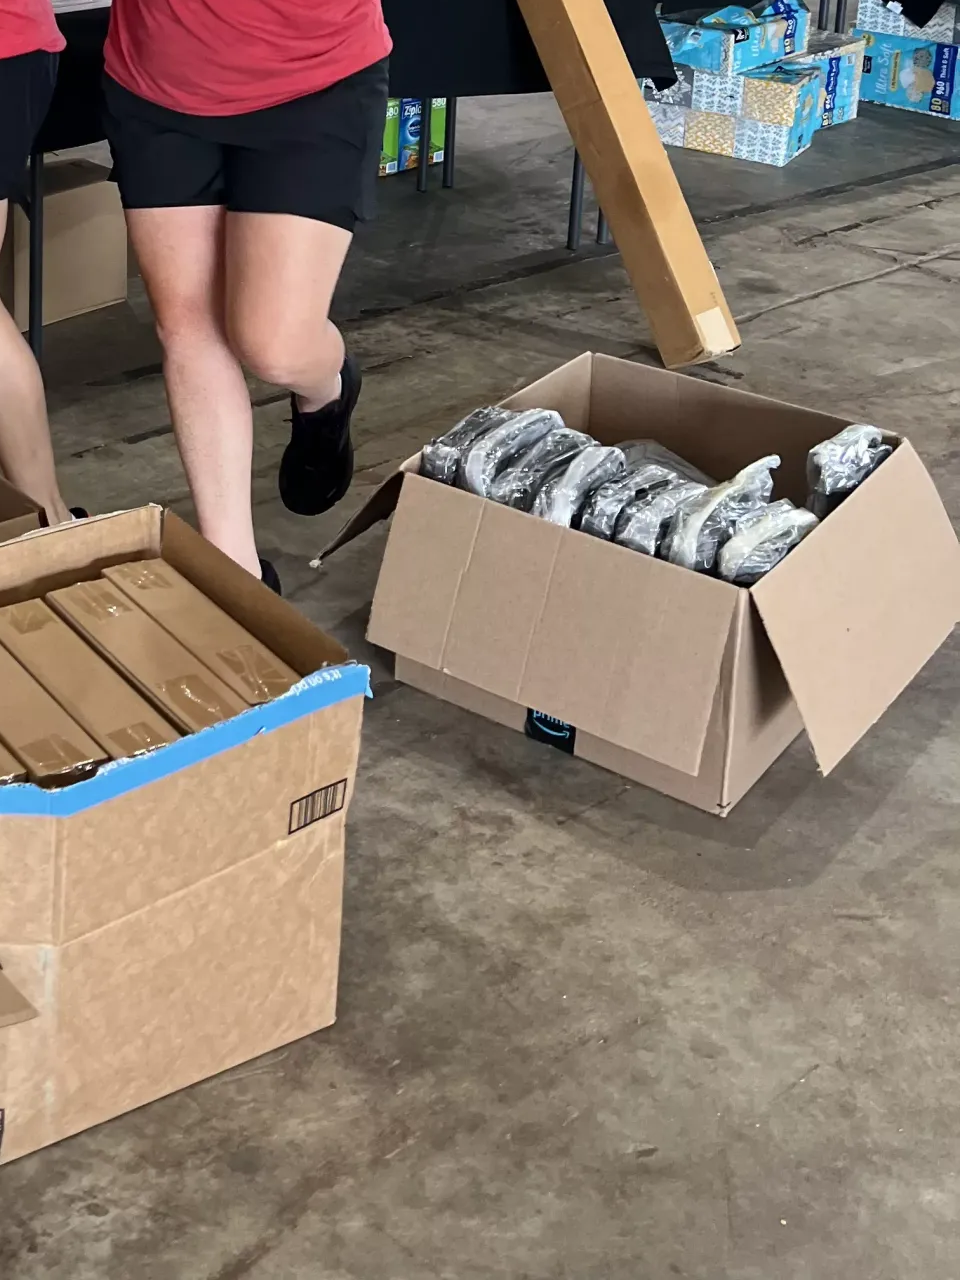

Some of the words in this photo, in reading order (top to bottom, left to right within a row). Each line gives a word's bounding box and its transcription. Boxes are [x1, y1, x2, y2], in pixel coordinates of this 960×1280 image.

[877, 43, 894, 66] Soft
[942, 47, 950, 59] Soft
[939, 64, 948, 79] Thick
[875, 68, 888, 95] Ultra
[935, 80, 945, 95] 960
[432, 97, 447, 108] 580
[930, 97, 942, 112] 80
[404, 104, 422, 118] Ziplo
[309, 675, 323, 687] on
[322, 668, 342, 682] It's
